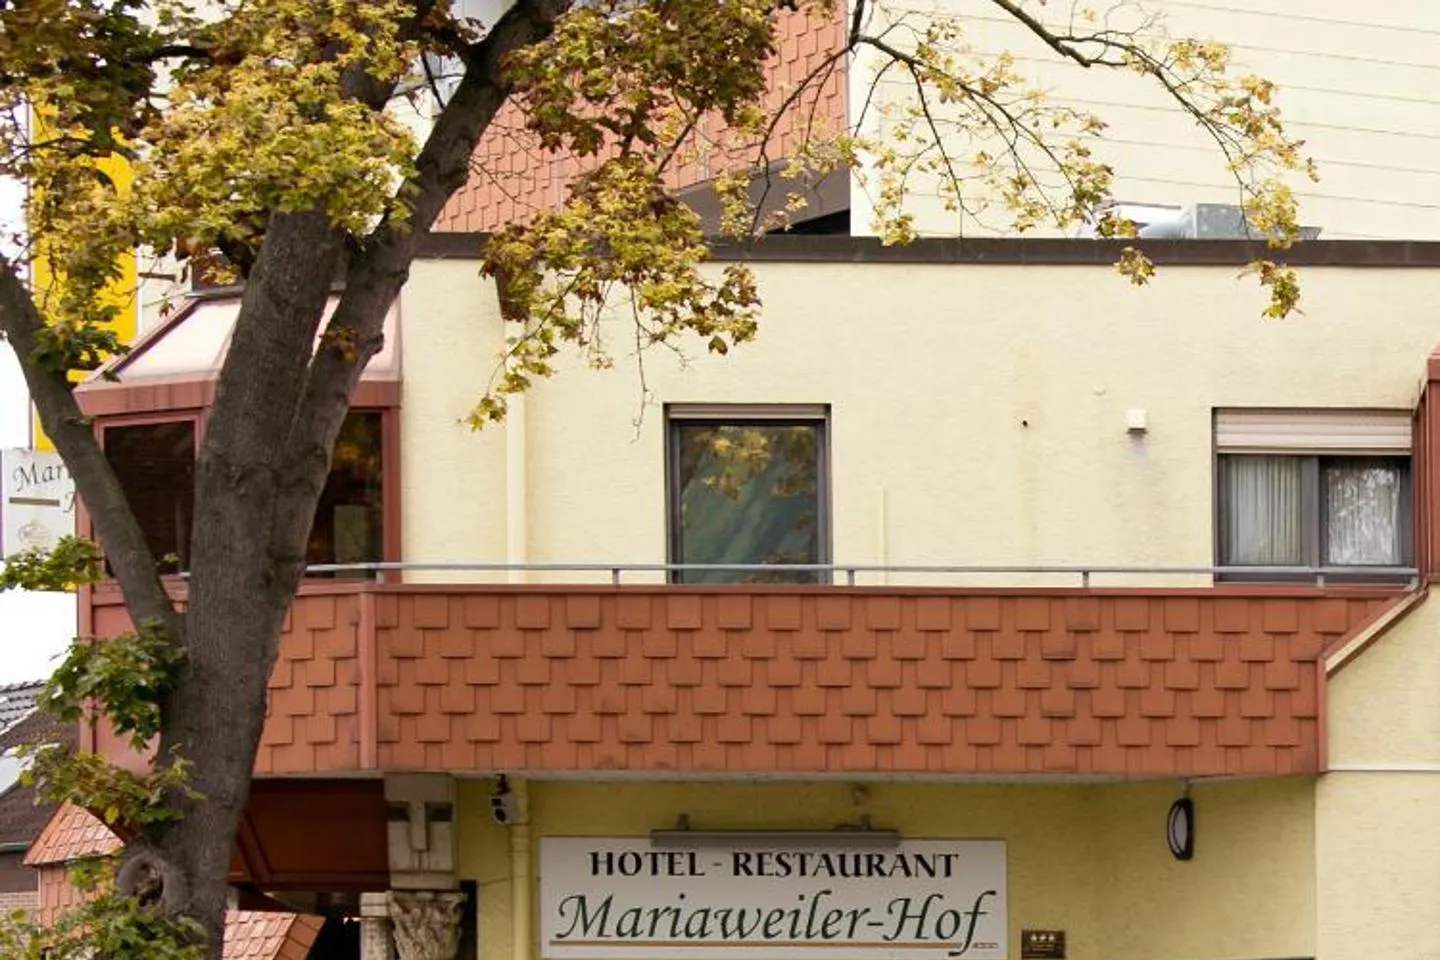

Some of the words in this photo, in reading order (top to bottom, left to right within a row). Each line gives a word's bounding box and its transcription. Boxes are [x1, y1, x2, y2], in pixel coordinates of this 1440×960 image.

[13, 462, 69, 492] Mar
[588, 851, 706, 877] HOTEL
[732, 852, 960, 878] RESTAURANT
[555, 889, 997, 957] Mariaweiler-Hof
